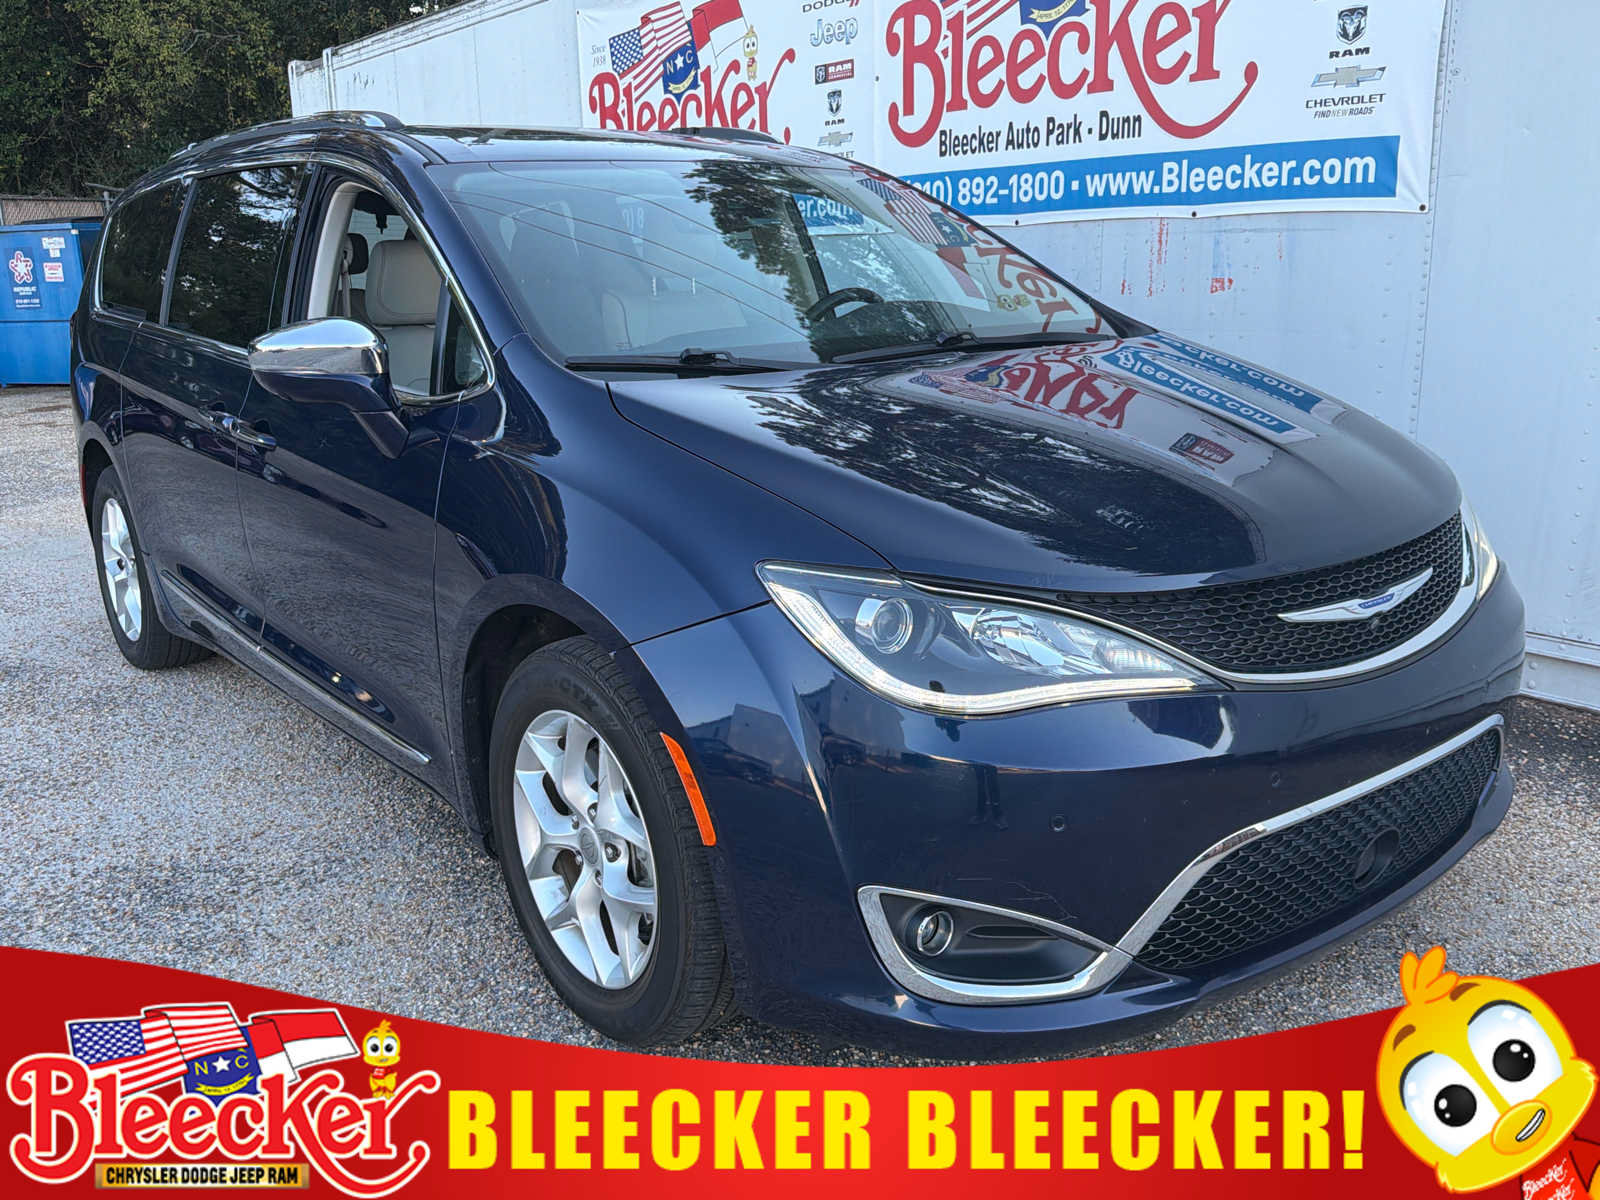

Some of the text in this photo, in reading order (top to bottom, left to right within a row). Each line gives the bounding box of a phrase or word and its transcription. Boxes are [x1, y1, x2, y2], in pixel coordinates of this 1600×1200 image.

[810, 17, 859, 47] Jeep
[828, 62, 852, 73] RAM
[1329, 46, 1370, 59] RAM
[885, 0, 1259, 148] Bleecker
[589, 48, 796, 145] Bleecker
[1305, 93, 1387, 108] CHEVROLET
[824, 118, 845, 127] RAM
[939, 110, 1142, 157] Bleecker Auto Park Dunn
[958, 170, 1065, 205] 892-1800
[1085, 152, 1378, 198] www.Bleecker.com
